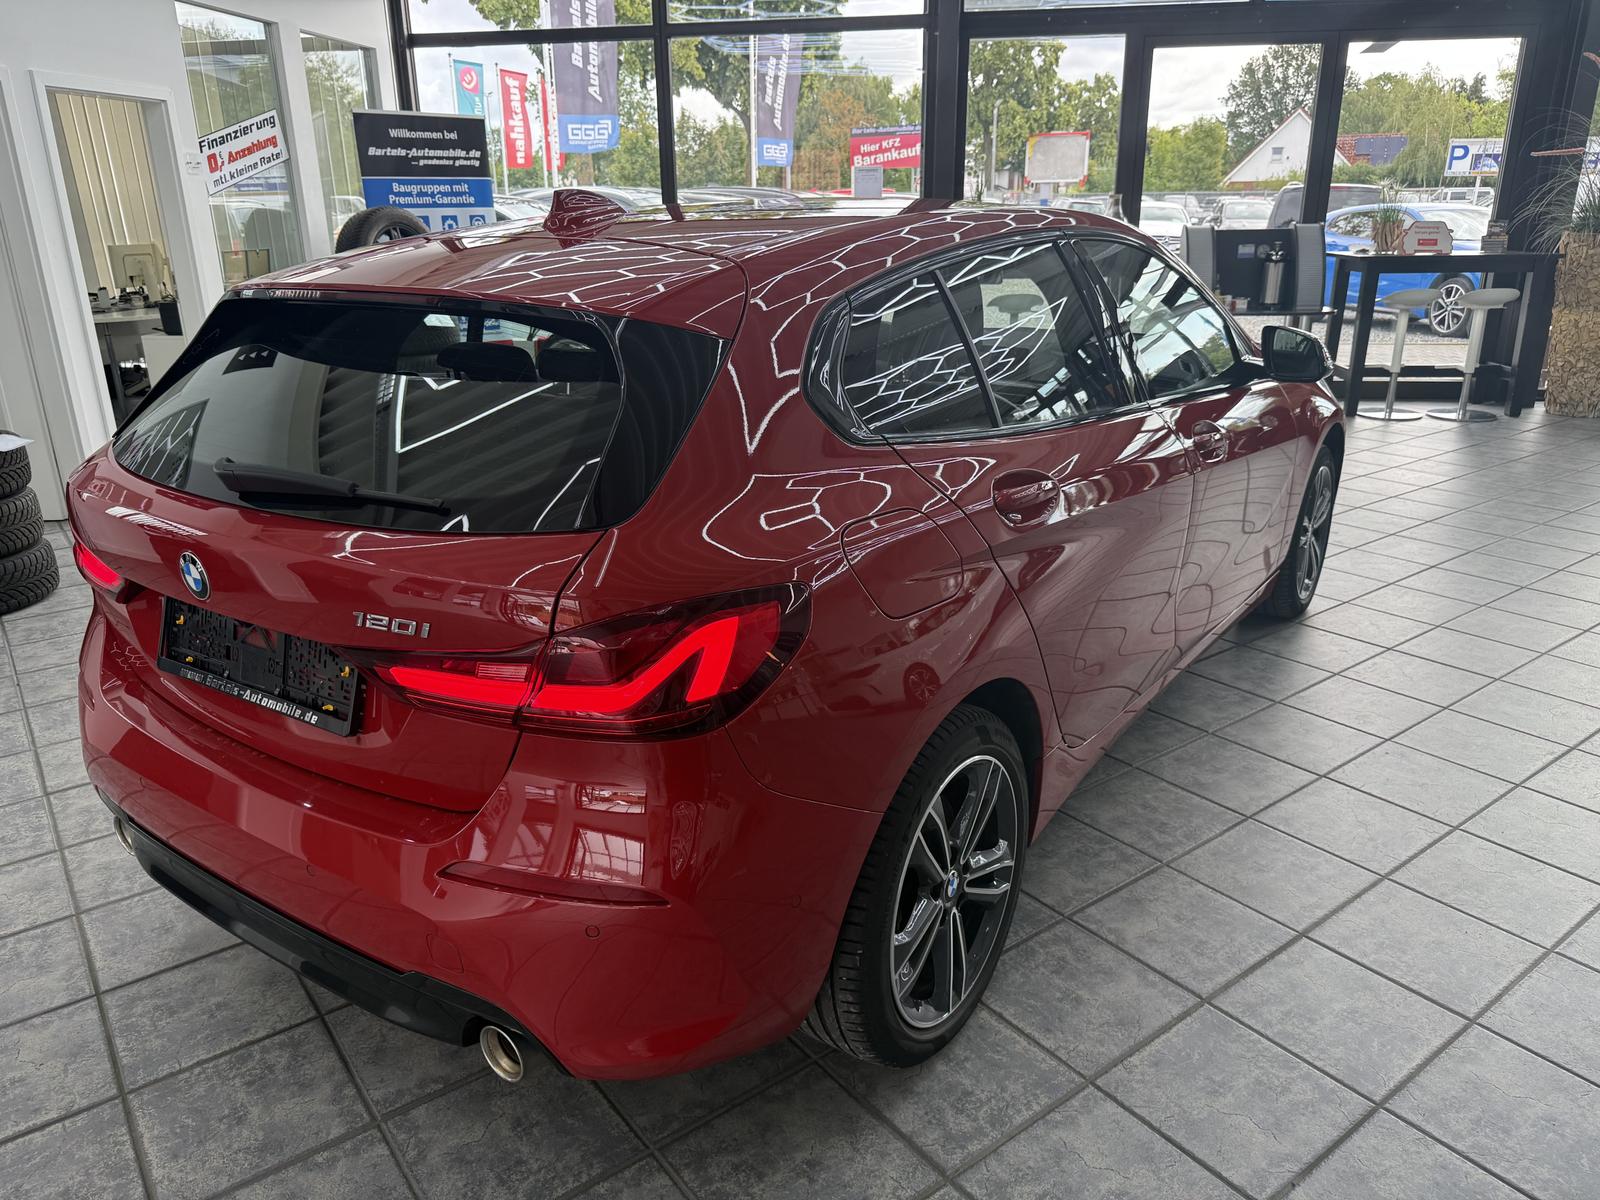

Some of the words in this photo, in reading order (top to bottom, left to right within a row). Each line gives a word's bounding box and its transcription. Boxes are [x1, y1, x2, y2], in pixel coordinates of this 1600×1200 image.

[569, 0, 583, 68] Baels
[505, 76, 526, 165] nahkauf
[198, 115, 277, 154] Finanzierung
[389, 128, 443, 139] Willkommen
[444, 130, 458, 140] bei
[227, 135, 278, 165] Anzahlung
[368, 147, 481, 158] Bartels-Automobile.de
[853, 143, 921, 167] Barankauf
[860, 143, 880, 153] Hier
[881, 138, 902, 149] KFZ
[260, 149, 284, 167] Rate!
[1447, 145, 1470, 170] P
[392, 182, 452, 194] Baugruppen
[453, 182, 469, 192] mit
[388, 194, 475, 205] Premium-Garantie
